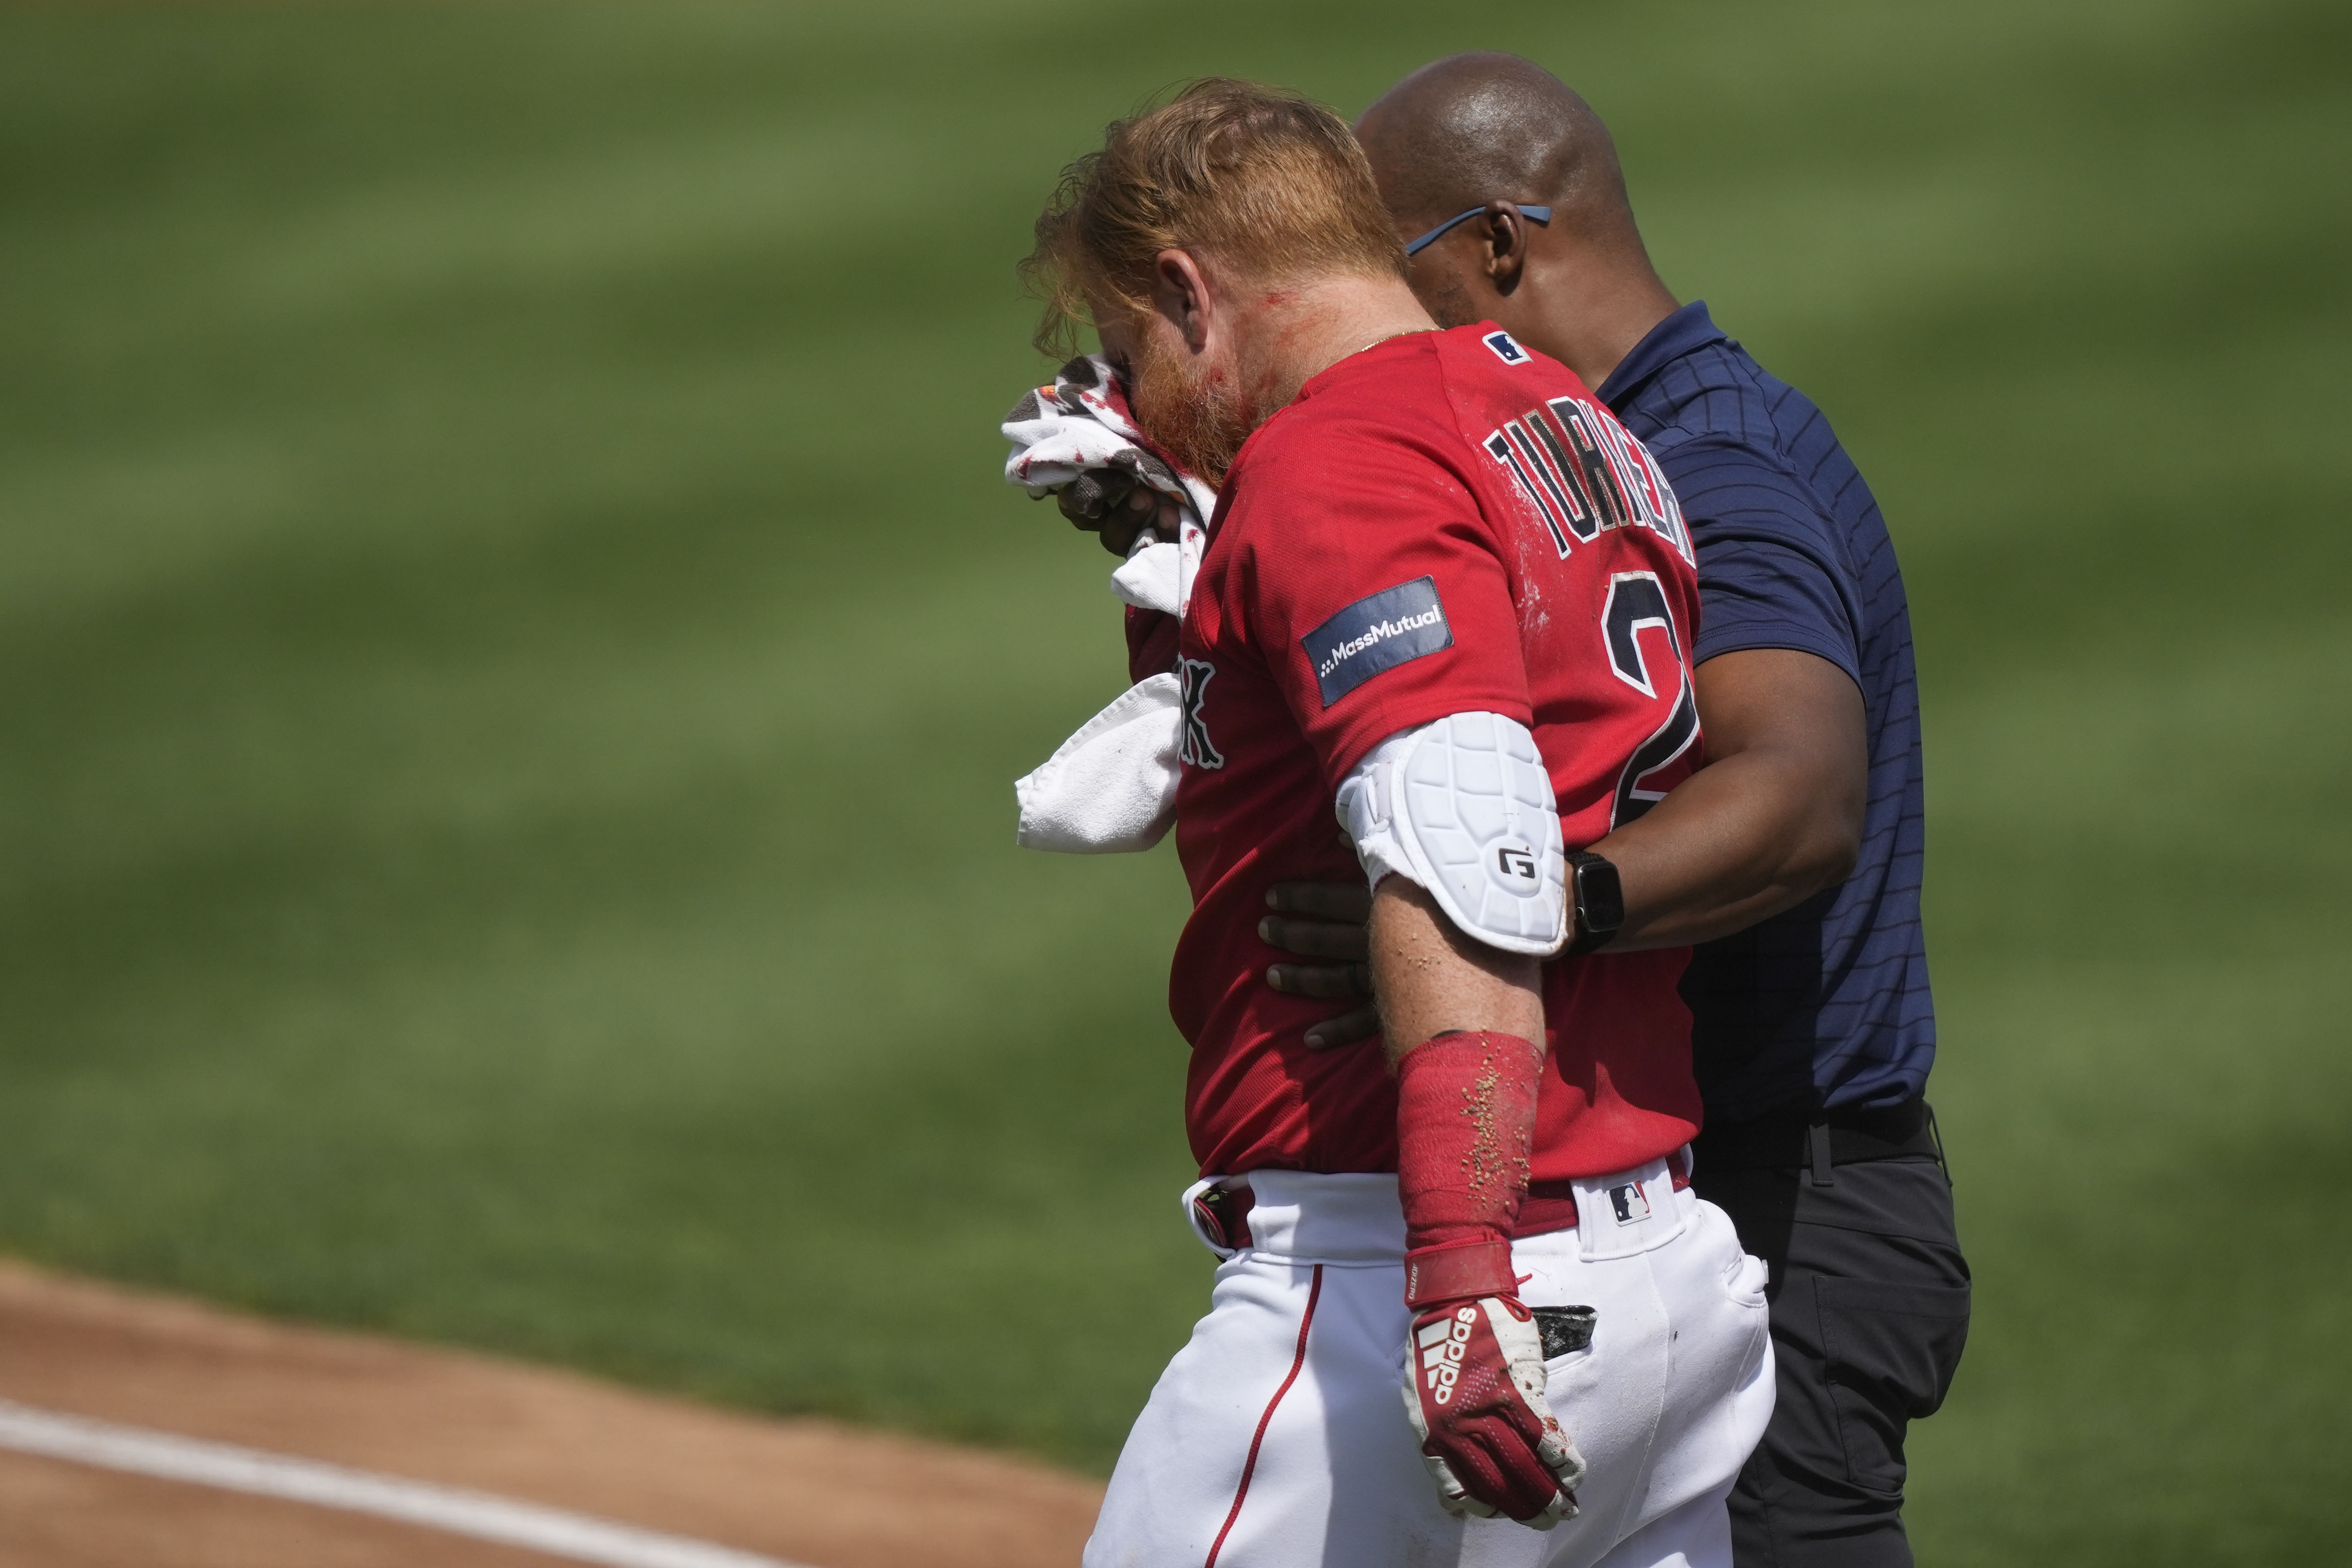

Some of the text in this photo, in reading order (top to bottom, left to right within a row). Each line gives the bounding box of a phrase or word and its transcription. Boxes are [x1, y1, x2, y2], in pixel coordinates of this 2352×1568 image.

[1332, 604, 1441, 665] MassMutual
[1601, 571, 1700, 833] 2
[1435, 1307, 1477, 1405] adidas
